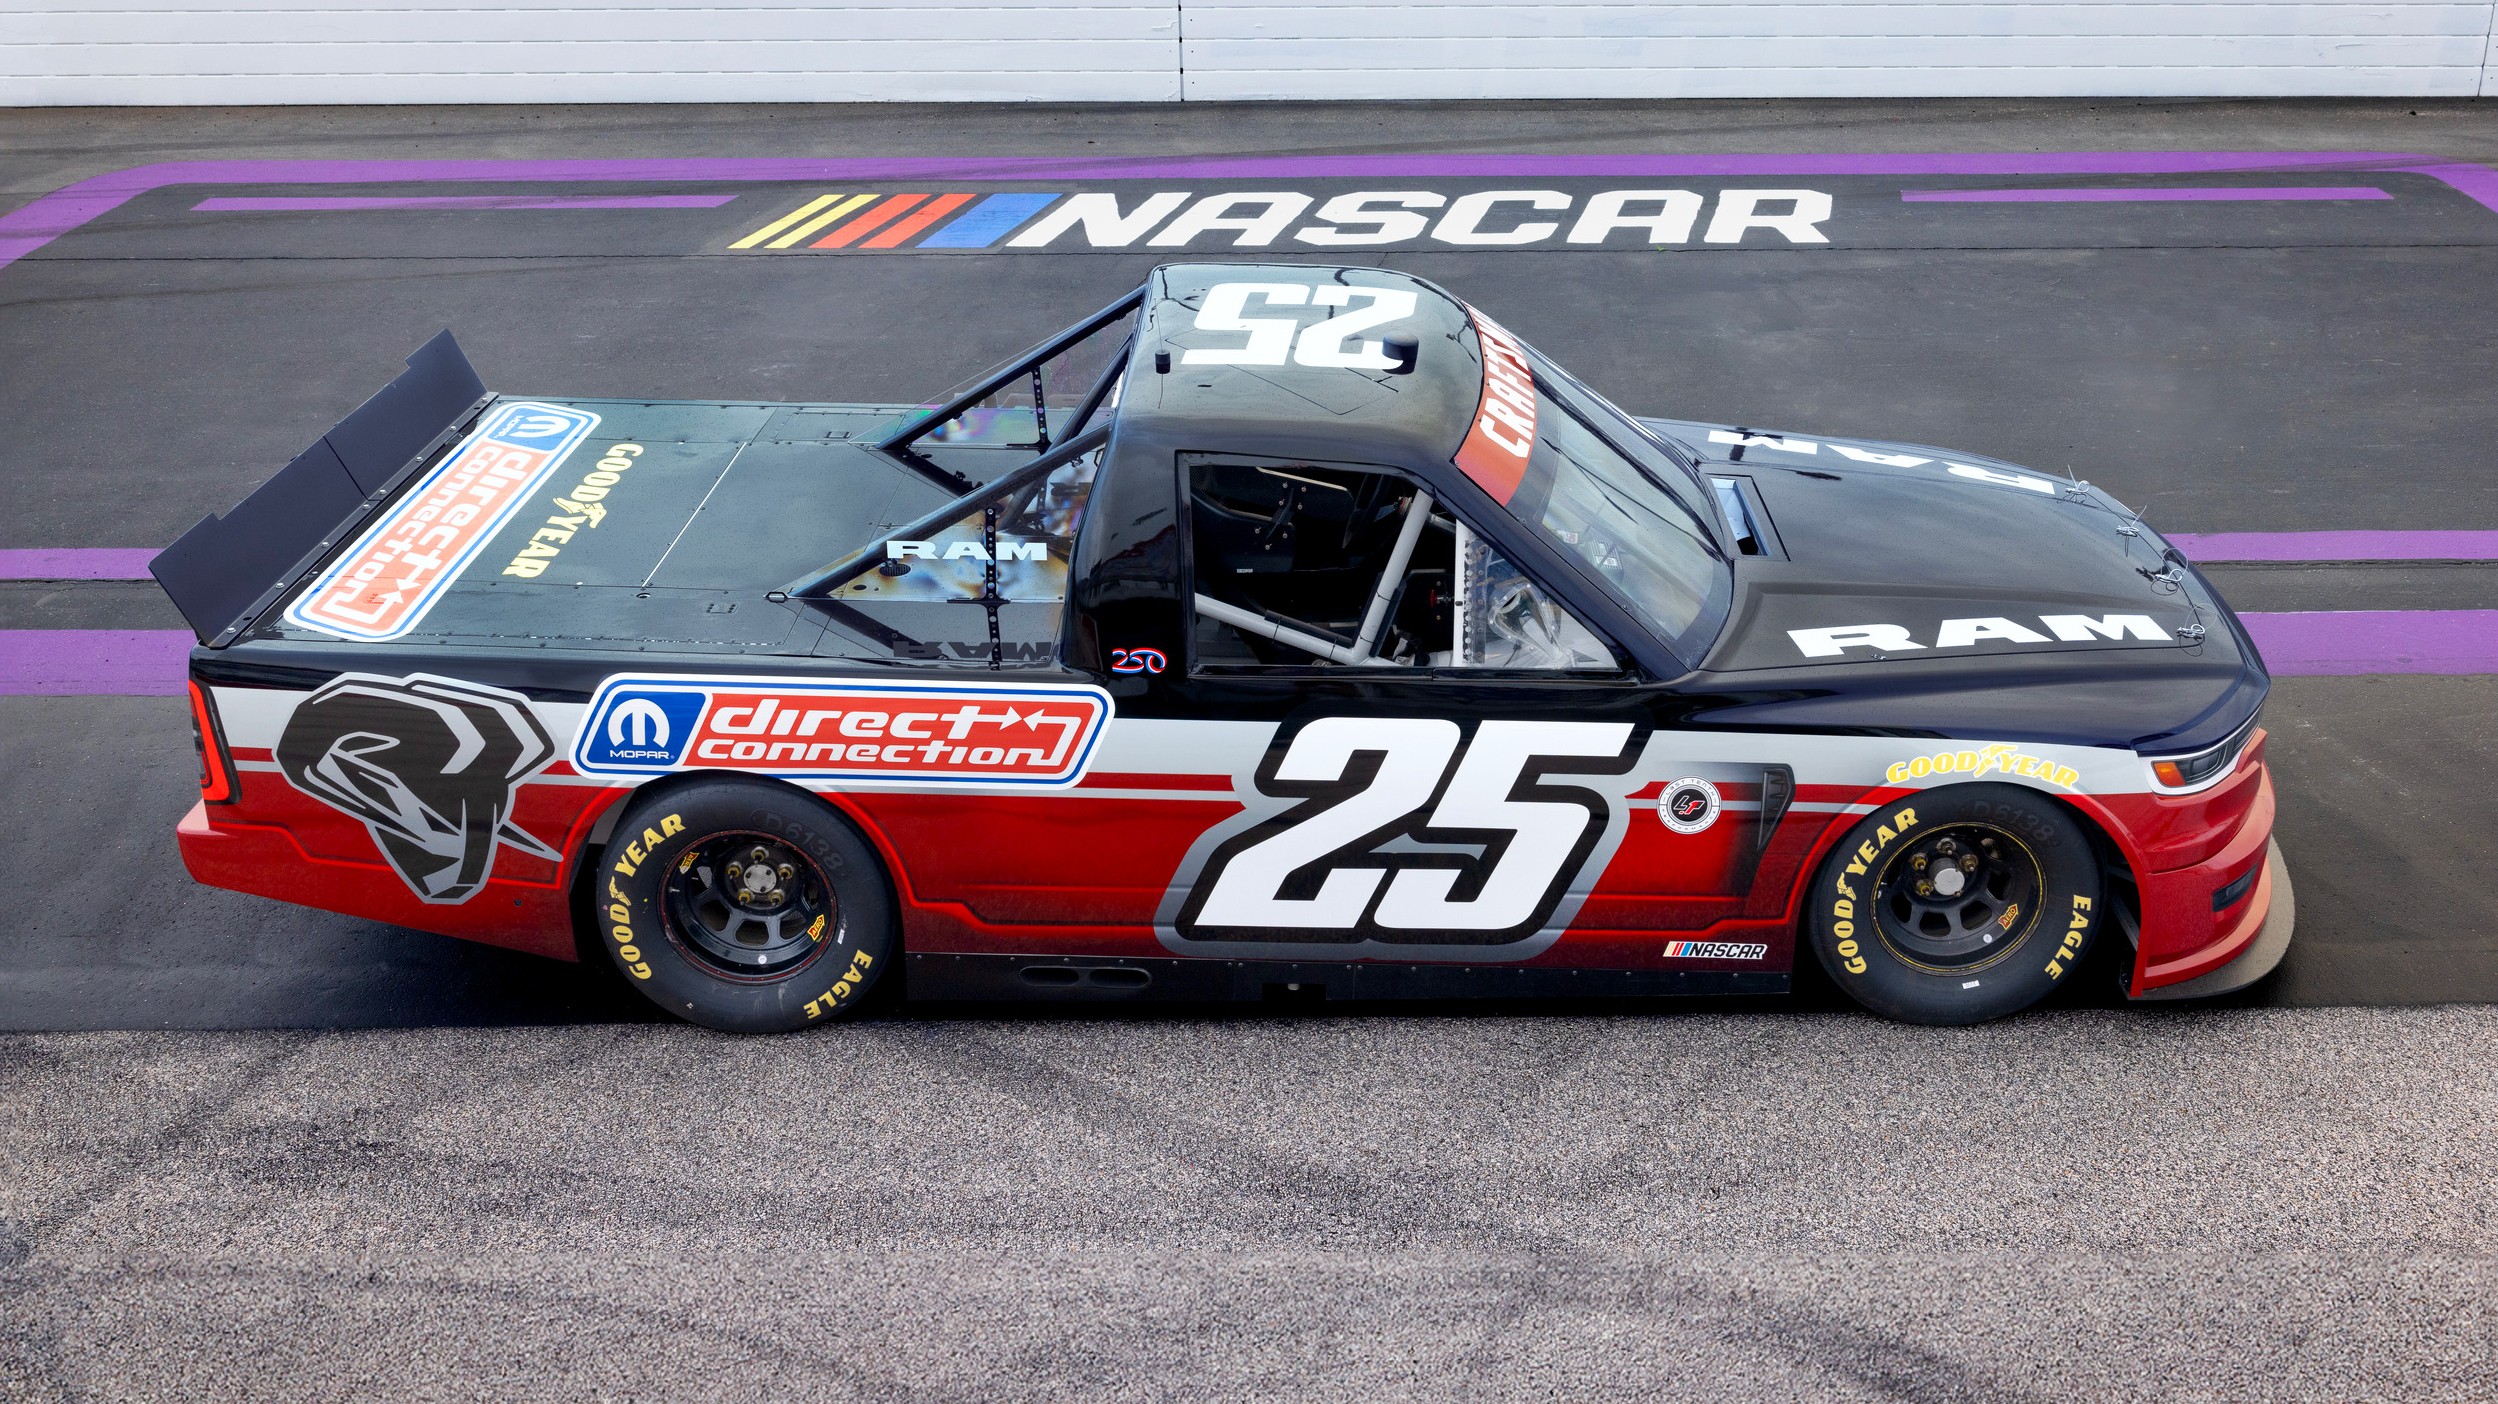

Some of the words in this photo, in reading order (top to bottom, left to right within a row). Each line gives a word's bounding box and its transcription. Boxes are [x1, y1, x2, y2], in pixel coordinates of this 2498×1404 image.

[1006, 189, 1833, 247] NASCAR
[1180, 282, 1417, 370] 25
[1707, 430, 2056, 495] RAM
[321, 444, 504, 612] connection
[400, 449, 530, 574] direct
[502, 443, 644, 578] GOODYEAR
[886, 540, 1048, 561] RAM
[1787, 614, 2173, 658] RAM
[697, 738, 1054, 767] connection
[709, 698, 985, 740] direct
[609, 749, 670, 760] MOPAR
[1887, 745, 2078, 787] GOODYEAR
[1193, 717, 1636, 930] 25
[609, 813, 686, 980] GOODYEAR
[1833, 807, 1919, 974] GOODYEAR
[1689, 942, 1765, 959] NASCAR
[2044, 894, 2092, 980] EAGLE
[803, 949, 874, 1020] EAGLE
